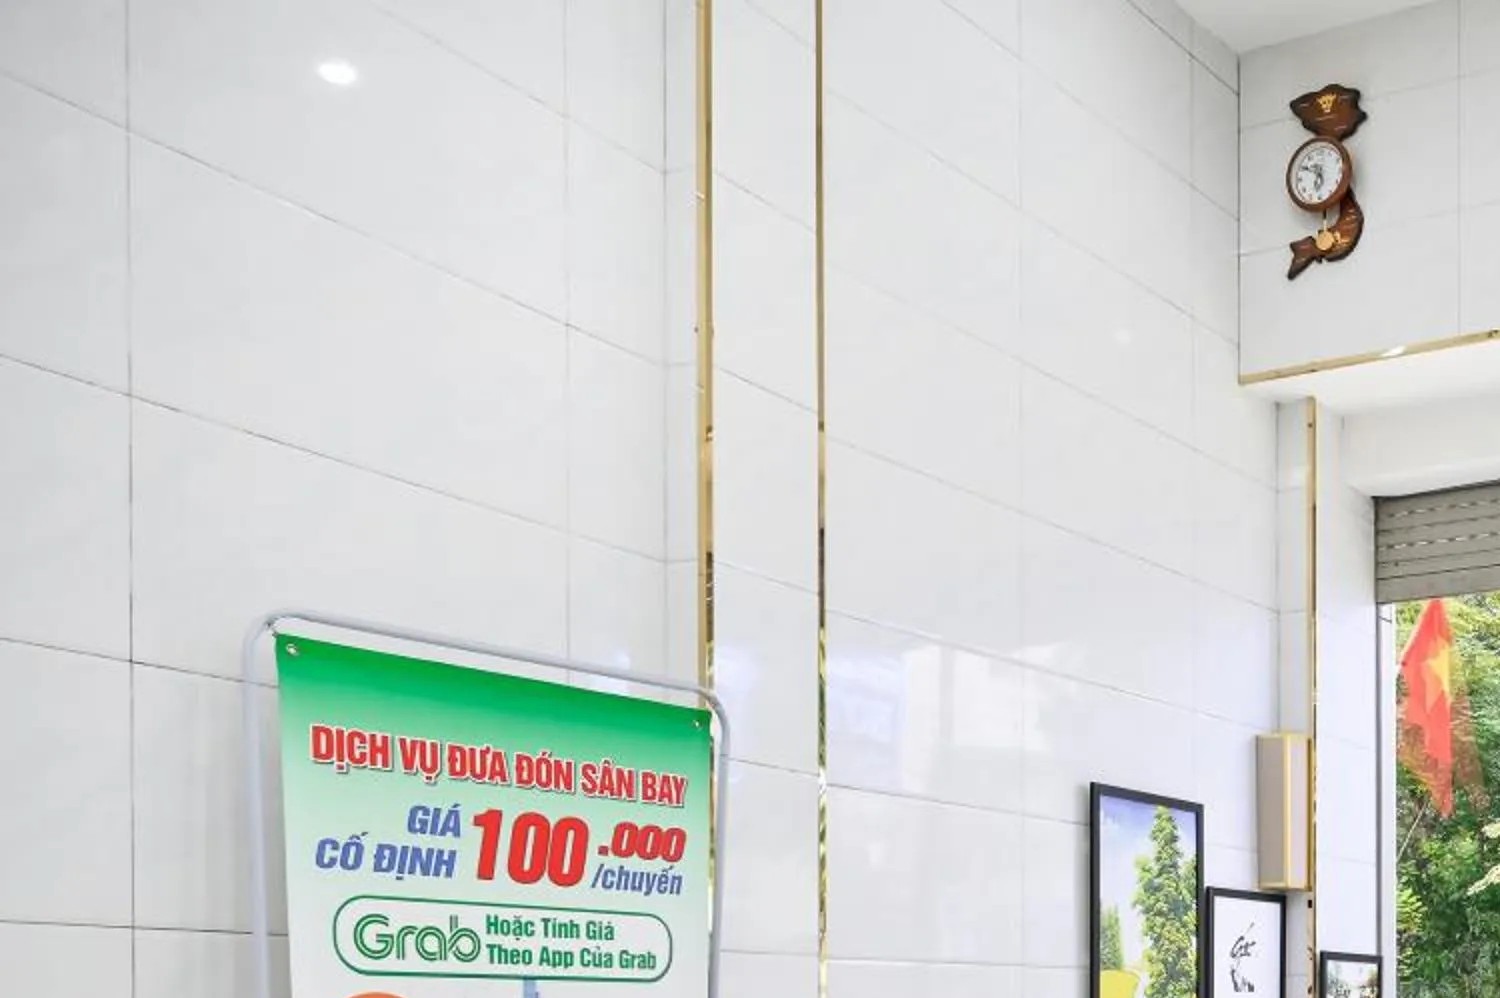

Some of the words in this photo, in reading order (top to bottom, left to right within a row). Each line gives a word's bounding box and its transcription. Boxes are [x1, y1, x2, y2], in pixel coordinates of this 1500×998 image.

[310, 724, 393, 774] DỊCH
[397, 736, 441, 784] VỤ
[446, 744, 510, 785] ĐƯA
[514, 751, 574, 793] ĐÓN
[580, 758, 637, 798] SÂN
[641, 770, 687, 807] BAY
[407, 803, 462, 838] GIÁ
[315, 831, 368, 871] CỐ
[373, 843, 457, 880] ĐỊNH
[353, 913, 481, 962] Grab
[486, 914, 535, 941] Hoặc
[486, 944, 533, 966] Theo
[538, 947, 575, 969] App
[580, 945, 614, 967] Của
[618, 950, 657, 969] Grab
